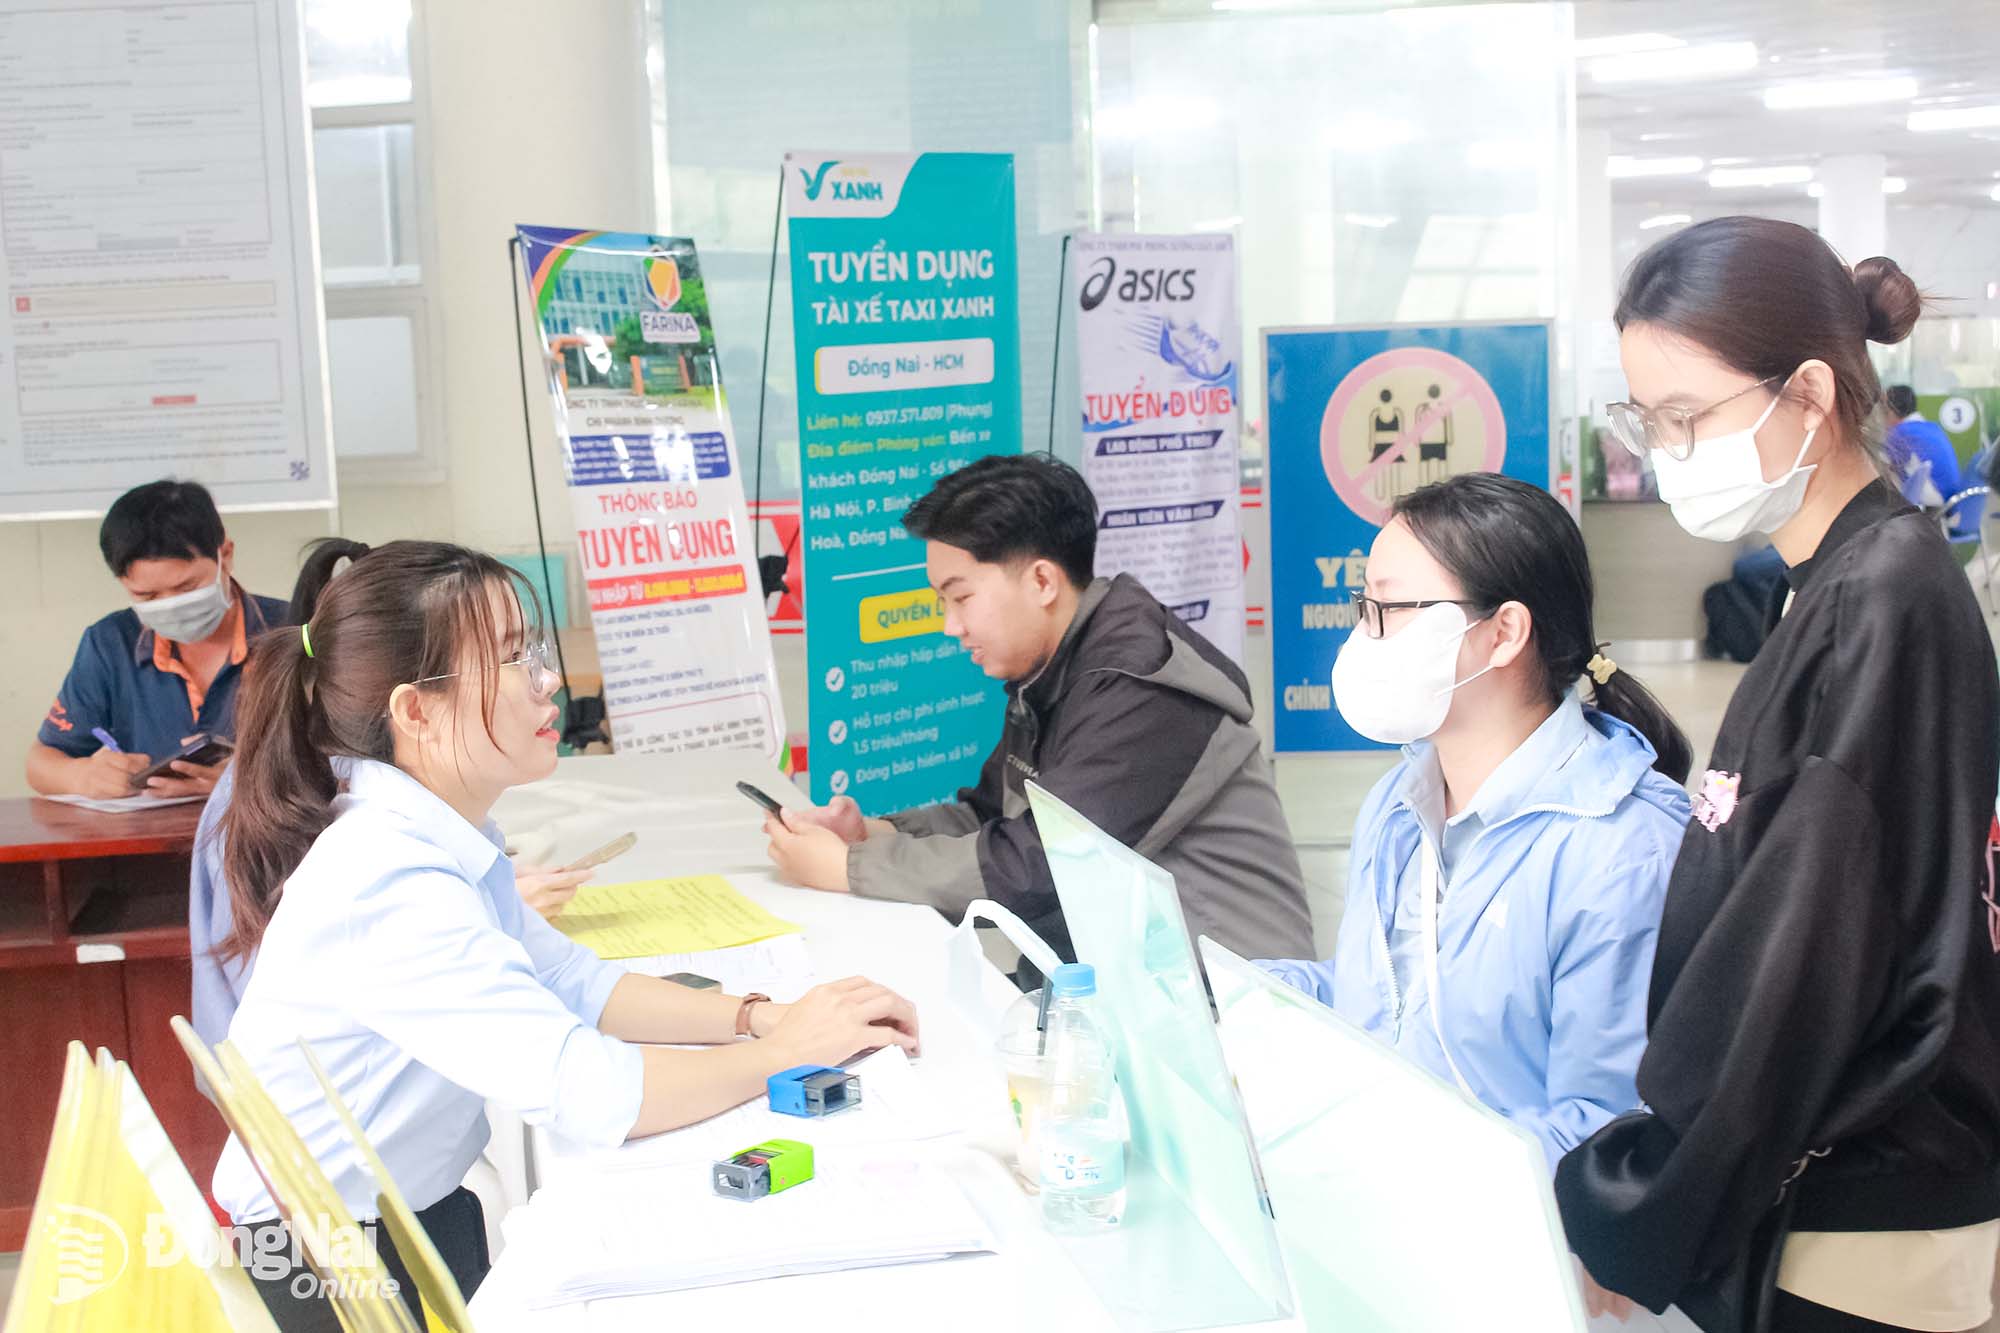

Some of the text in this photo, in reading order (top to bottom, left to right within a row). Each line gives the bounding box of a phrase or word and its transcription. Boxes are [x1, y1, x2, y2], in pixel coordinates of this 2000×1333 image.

[832, 181, 883, 200] XANH
[808, 239, 994, 288] TUYỂN DỤNG
[812, 291, 994, 325] TÀI XẾ TAXI XANH
[642, 314, 695, 331] FARINA
[896, 354, 920, 373] Nai
[934, 353, 964, 370] HCM
[1085, 375, 1161, 423] TUYỂN
[1951, 407, 1963, 425] 3
[899, 462, 920, 479] Nai
[1315, 548, 1368, 588] YÊ
[851, 683, 867, 699] 20
